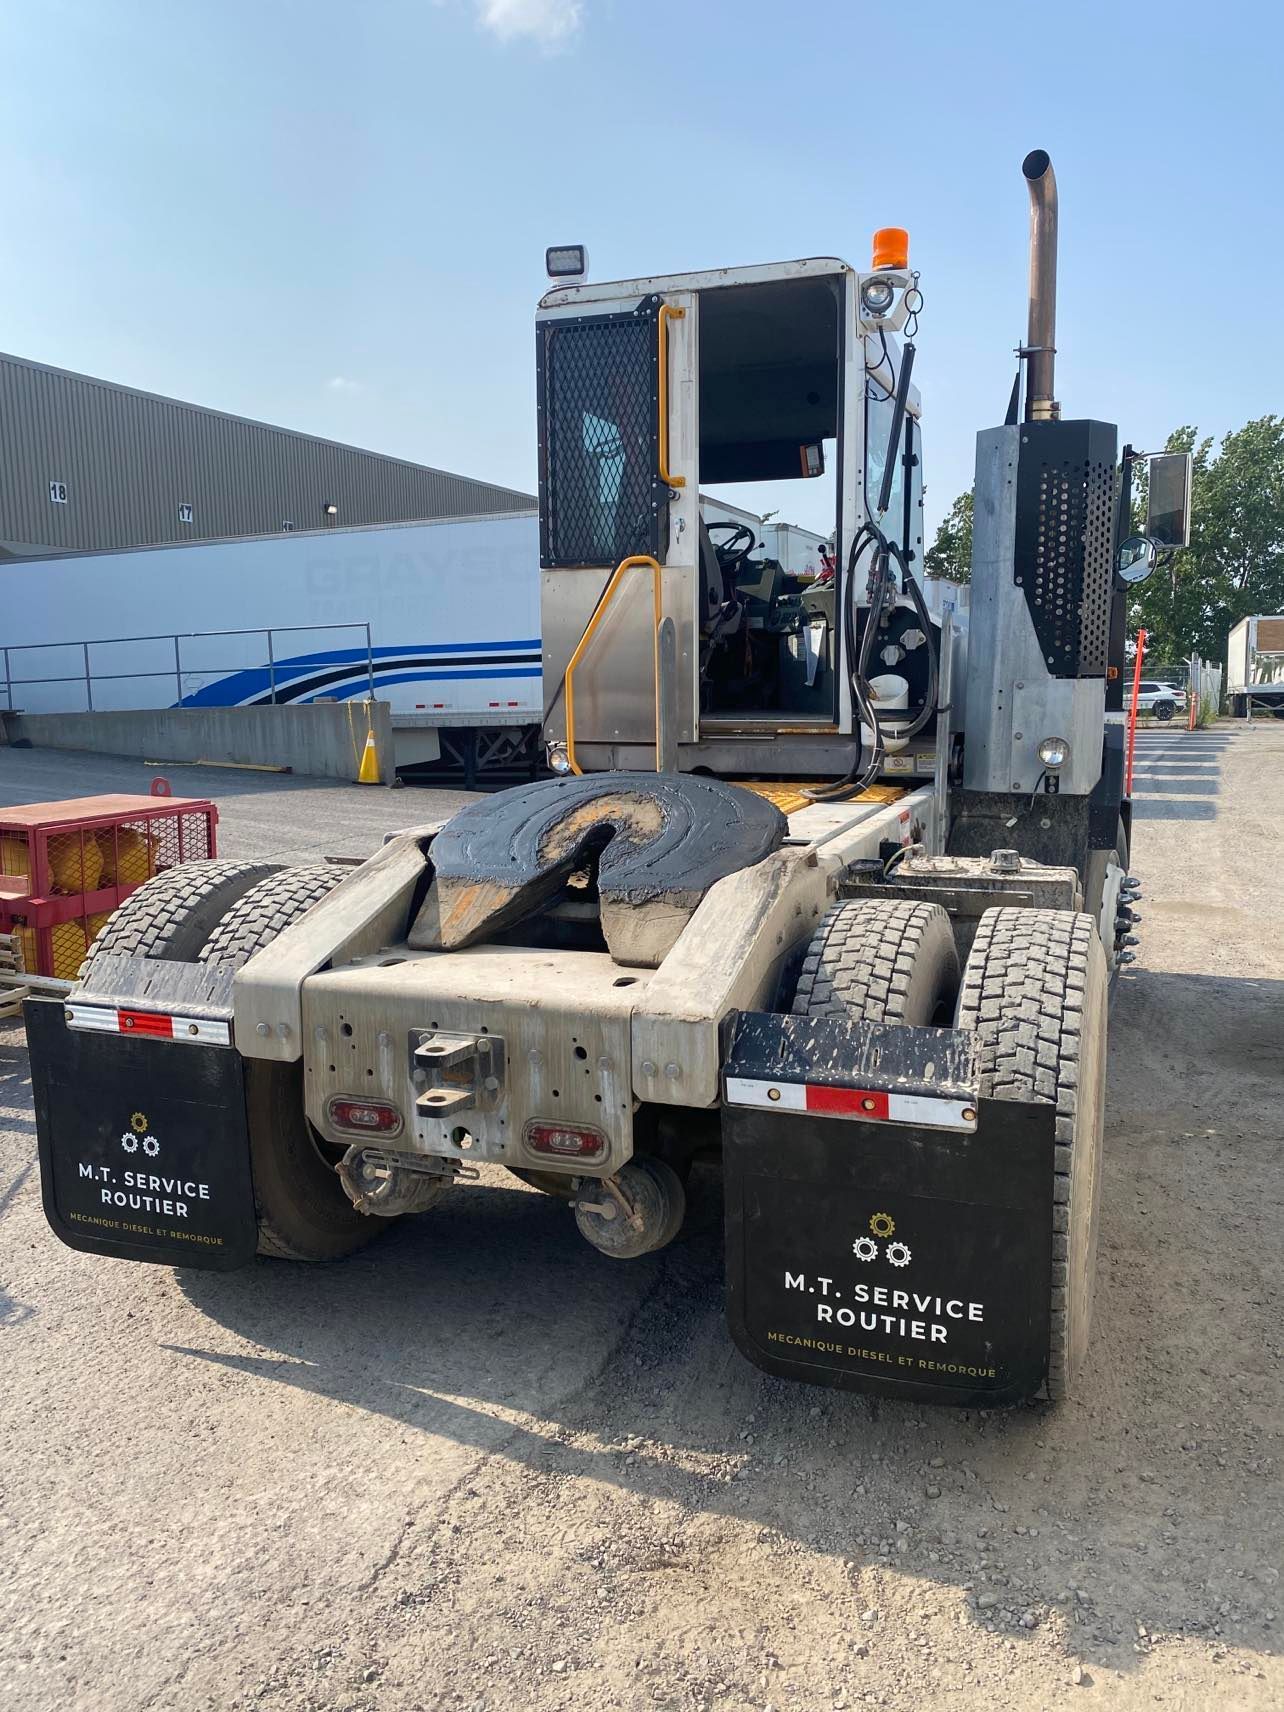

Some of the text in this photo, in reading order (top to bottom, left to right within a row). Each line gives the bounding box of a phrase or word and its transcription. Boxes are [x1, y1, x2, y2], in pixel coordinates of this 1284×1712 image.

[50, 483, 67, 500] 18
[179, 504, 193, 520] 17
[78, 1162, 210, 1200] M.T. SERVICE
[101, 1188, 188, 1218] ROUTIER
[69, 1212, 224, 1246] MECANIQUE DIESEL ET REMORQUE
[784, 1271, 984, 1322] M.T. SERVICE
[817, 1303, 948, 1344] ROUTIER
[768, 1331, 996, 1378] MECANIQUE DIESEL ET REMORQUE
